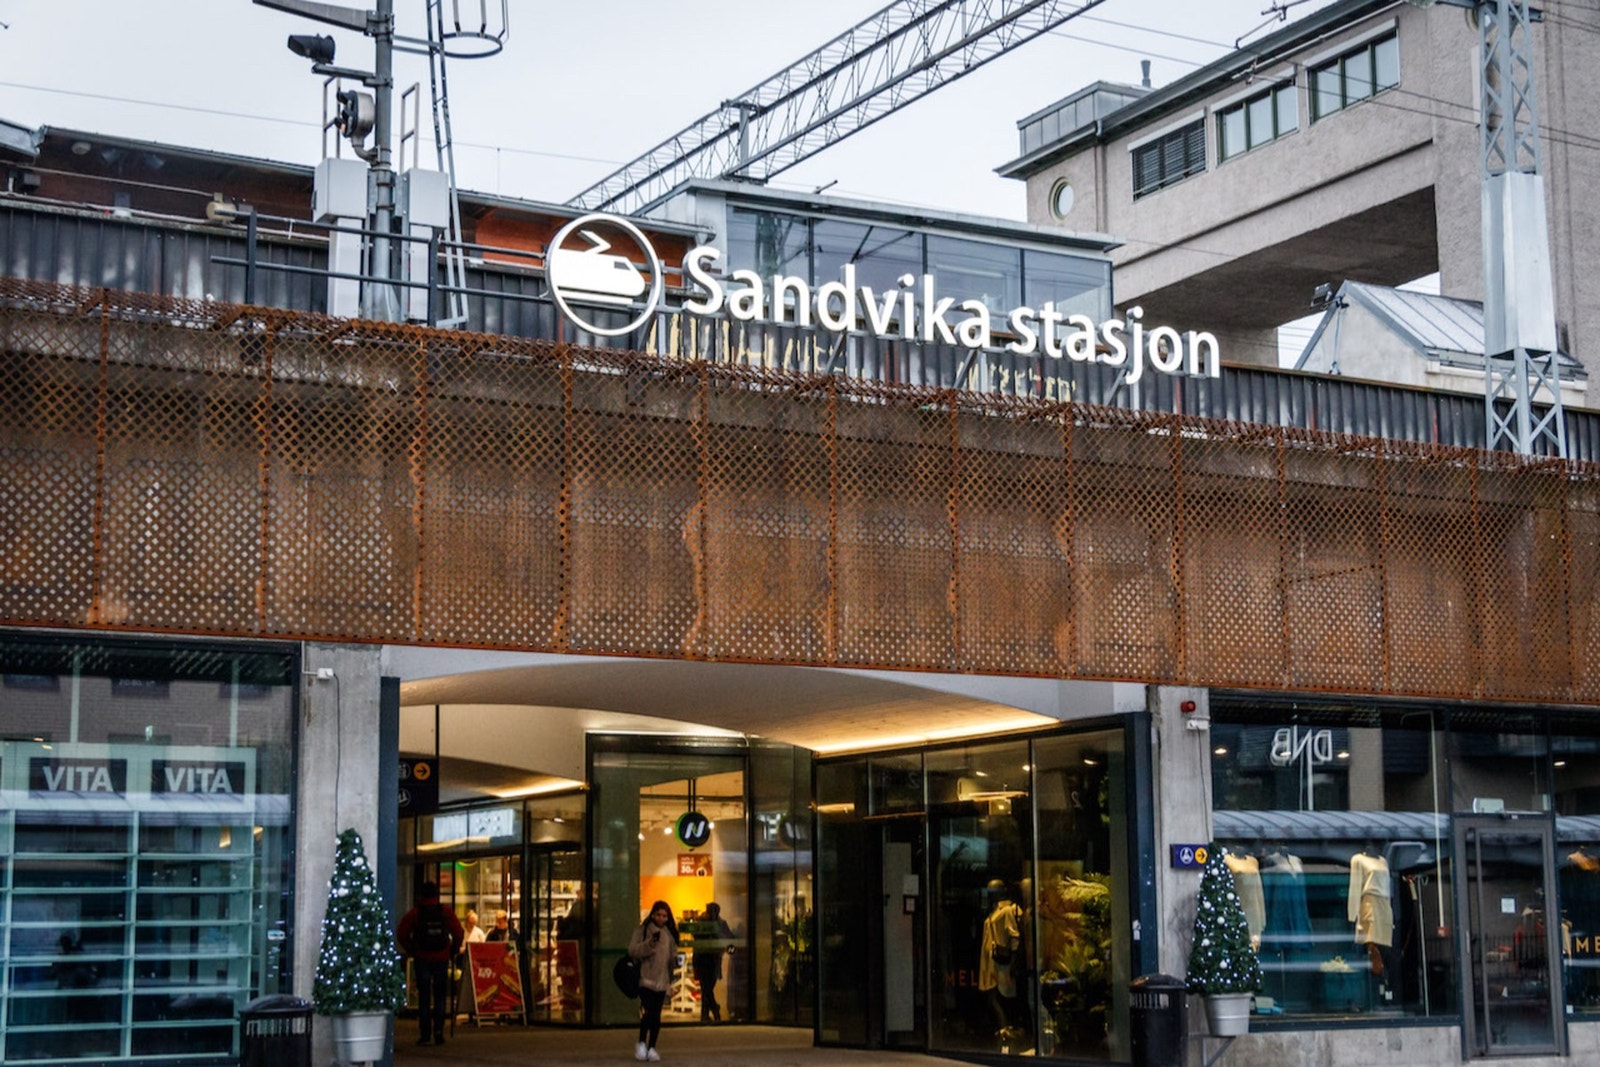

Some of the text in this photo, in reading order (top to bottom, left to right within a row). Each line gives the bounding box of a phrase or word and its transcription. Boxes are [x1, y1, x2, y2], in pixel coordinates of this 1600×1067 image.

[683, 246, 991, 348] Sandvika
[1005, 301, 1220, 384] stasjon
[43, 766, 114, 792] VITA
[164, 767, 233, 793] VITA
